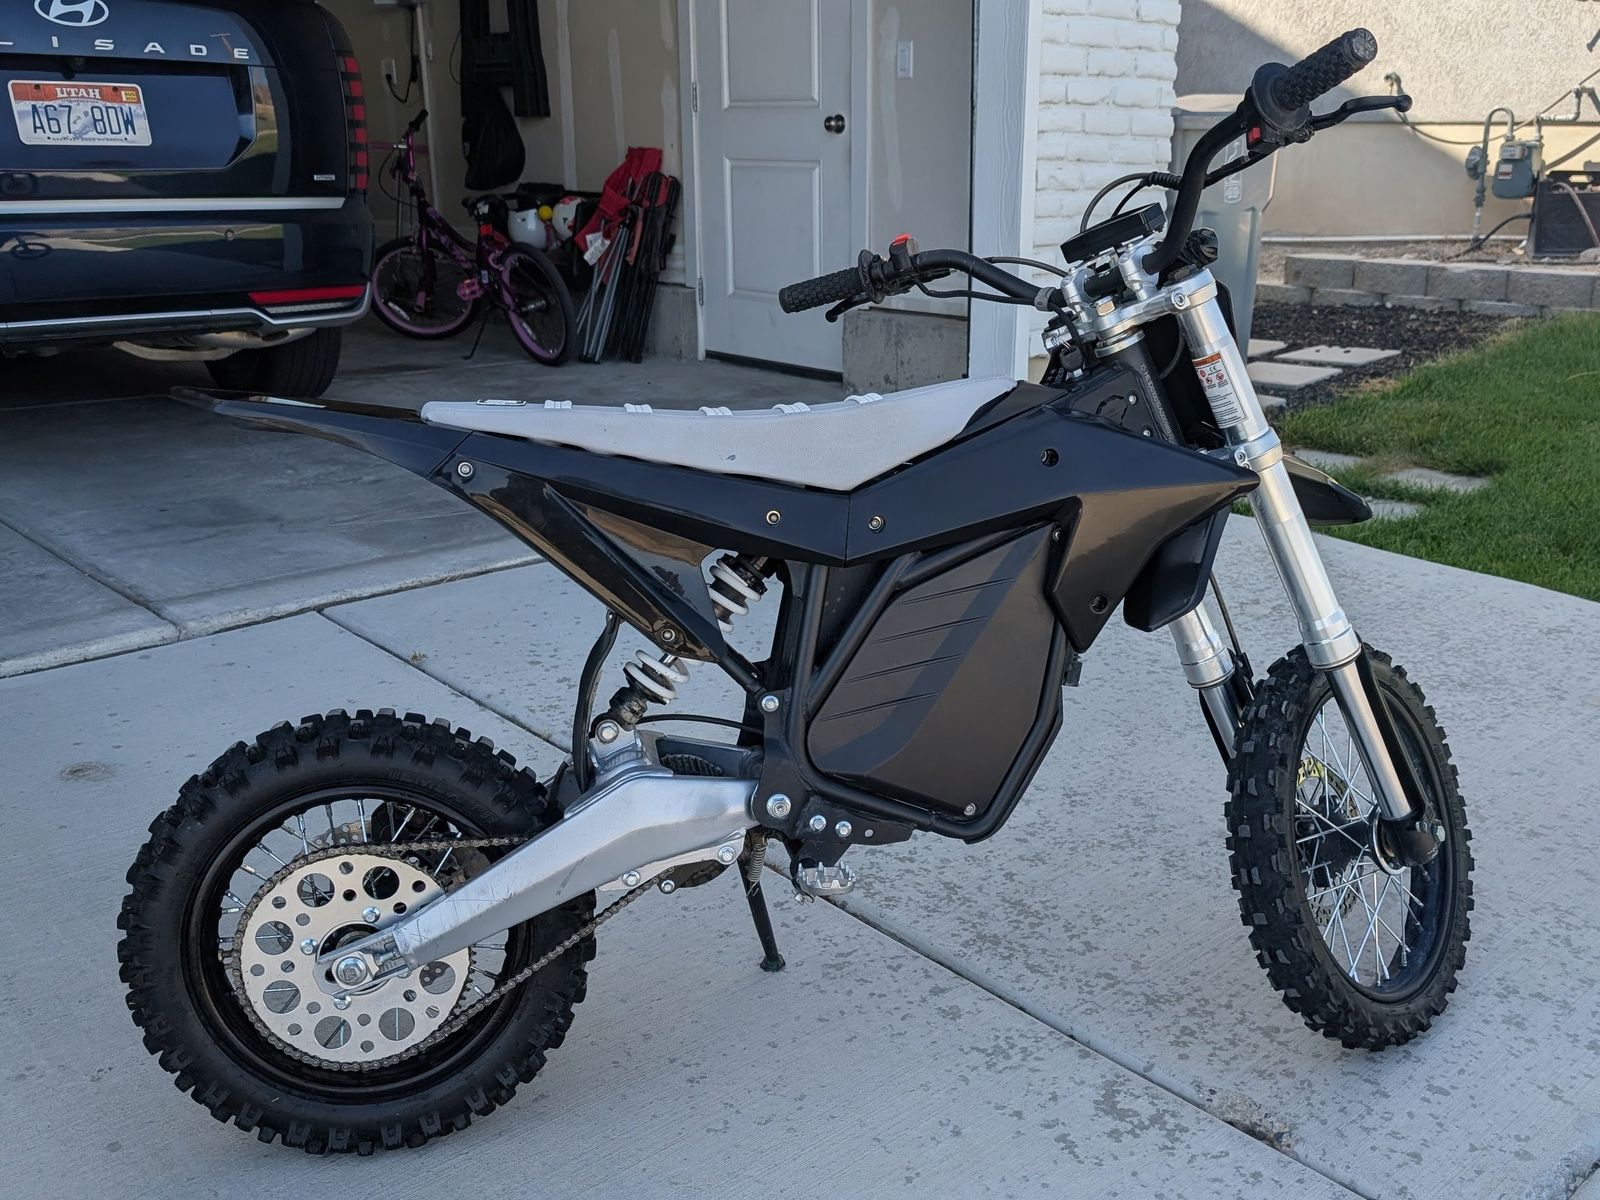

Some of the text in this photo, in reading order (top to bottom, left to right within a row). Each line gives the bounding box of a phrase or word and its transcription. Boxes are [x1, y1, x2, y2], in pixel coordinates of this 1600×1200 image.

[55, 87, 101, 99] UTAH
[31, 104, 136, 135] A67 8DW
